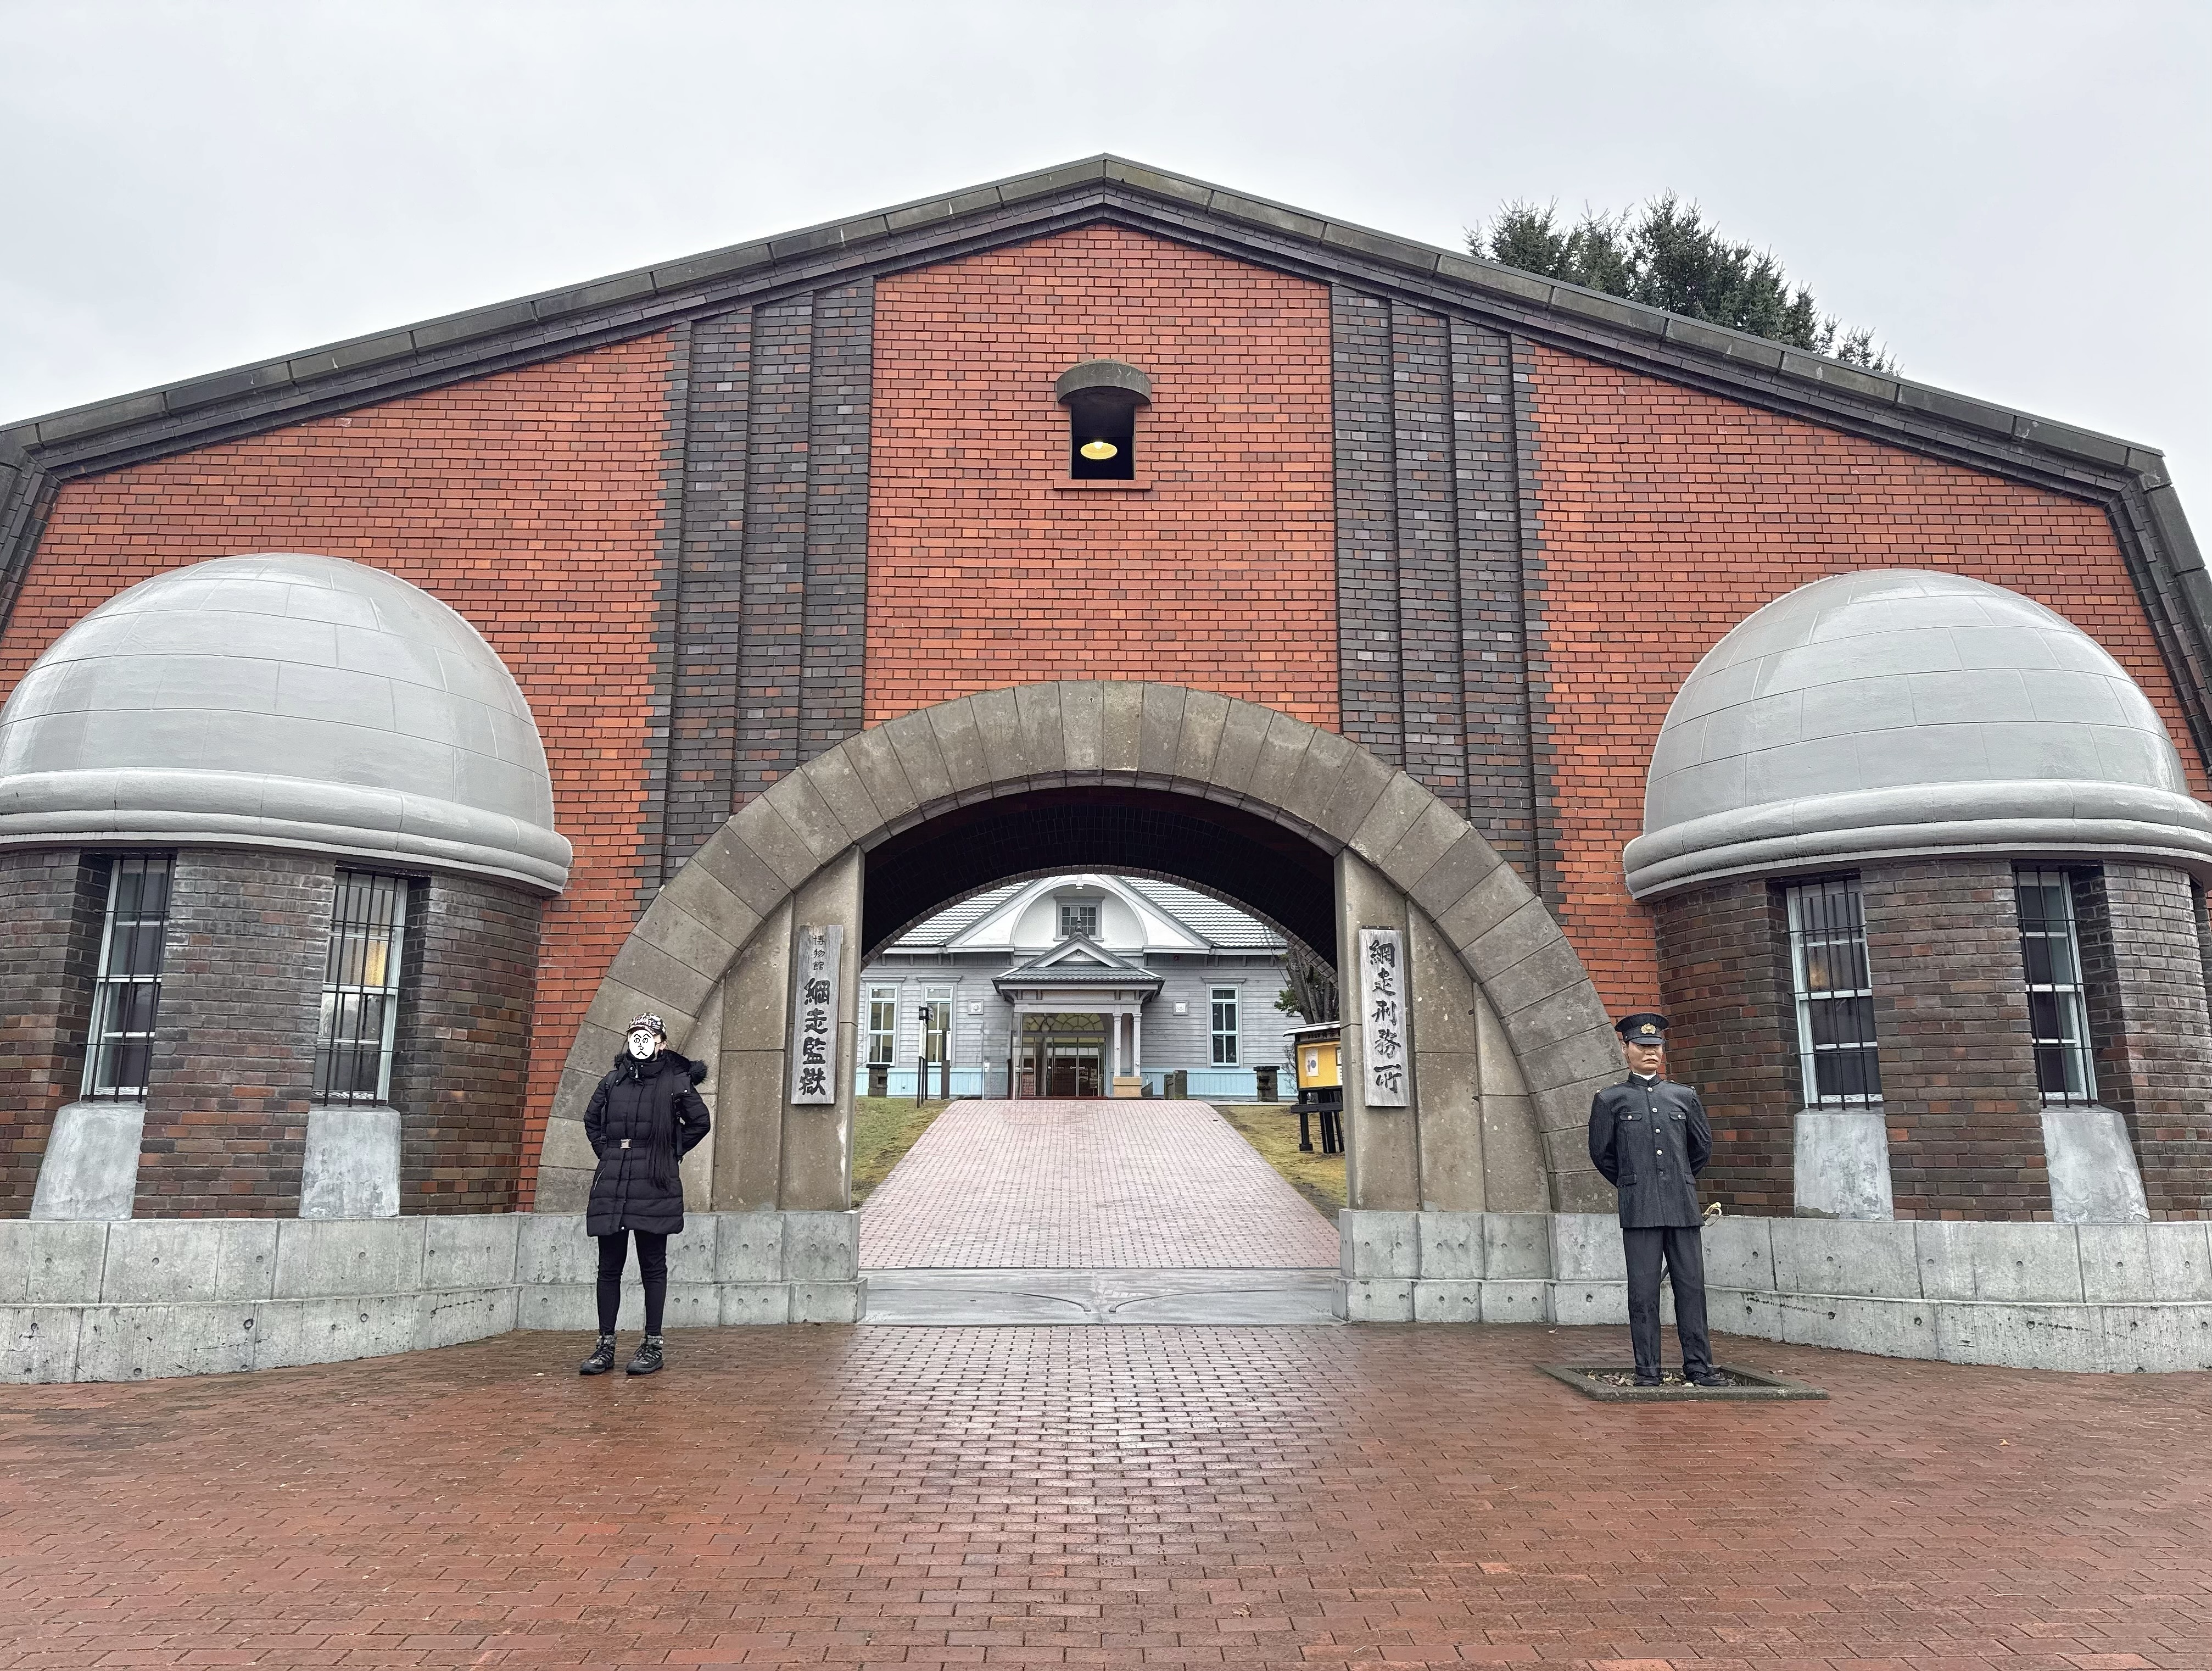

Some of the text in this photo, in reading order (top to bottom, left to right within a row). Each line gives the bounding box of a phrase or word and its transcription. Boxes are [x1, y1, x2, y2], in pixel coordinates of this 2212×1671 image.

[799, 935, 830, 1095] 博物館 網走監獄
[1369, 940, 1402, 1094] 網走刑務所
